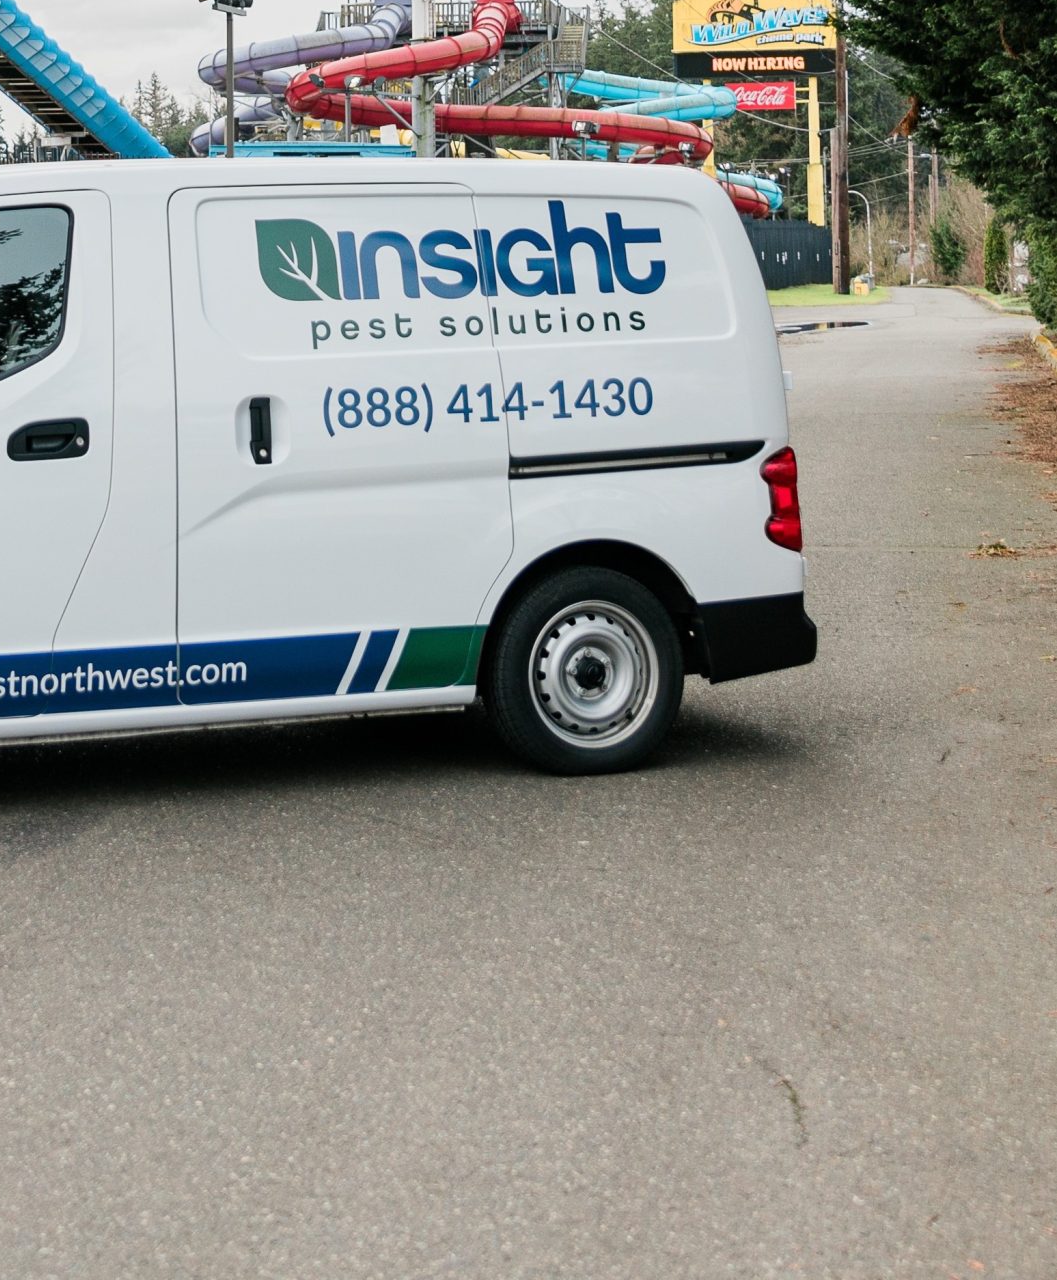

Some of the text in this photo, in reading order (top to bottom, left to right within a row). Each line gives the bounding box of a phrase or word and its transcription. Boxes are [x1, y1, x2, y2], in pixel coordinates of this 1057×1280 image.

[756, 32, 825, 46] theme park
[712, 56, 805, 71] NOW HIRING
[735, 85, 788, 106] Coca-Cola
[311, 306, 645, 349] pest solutions
[323, 377, 653, 437] (888) 414-1430
